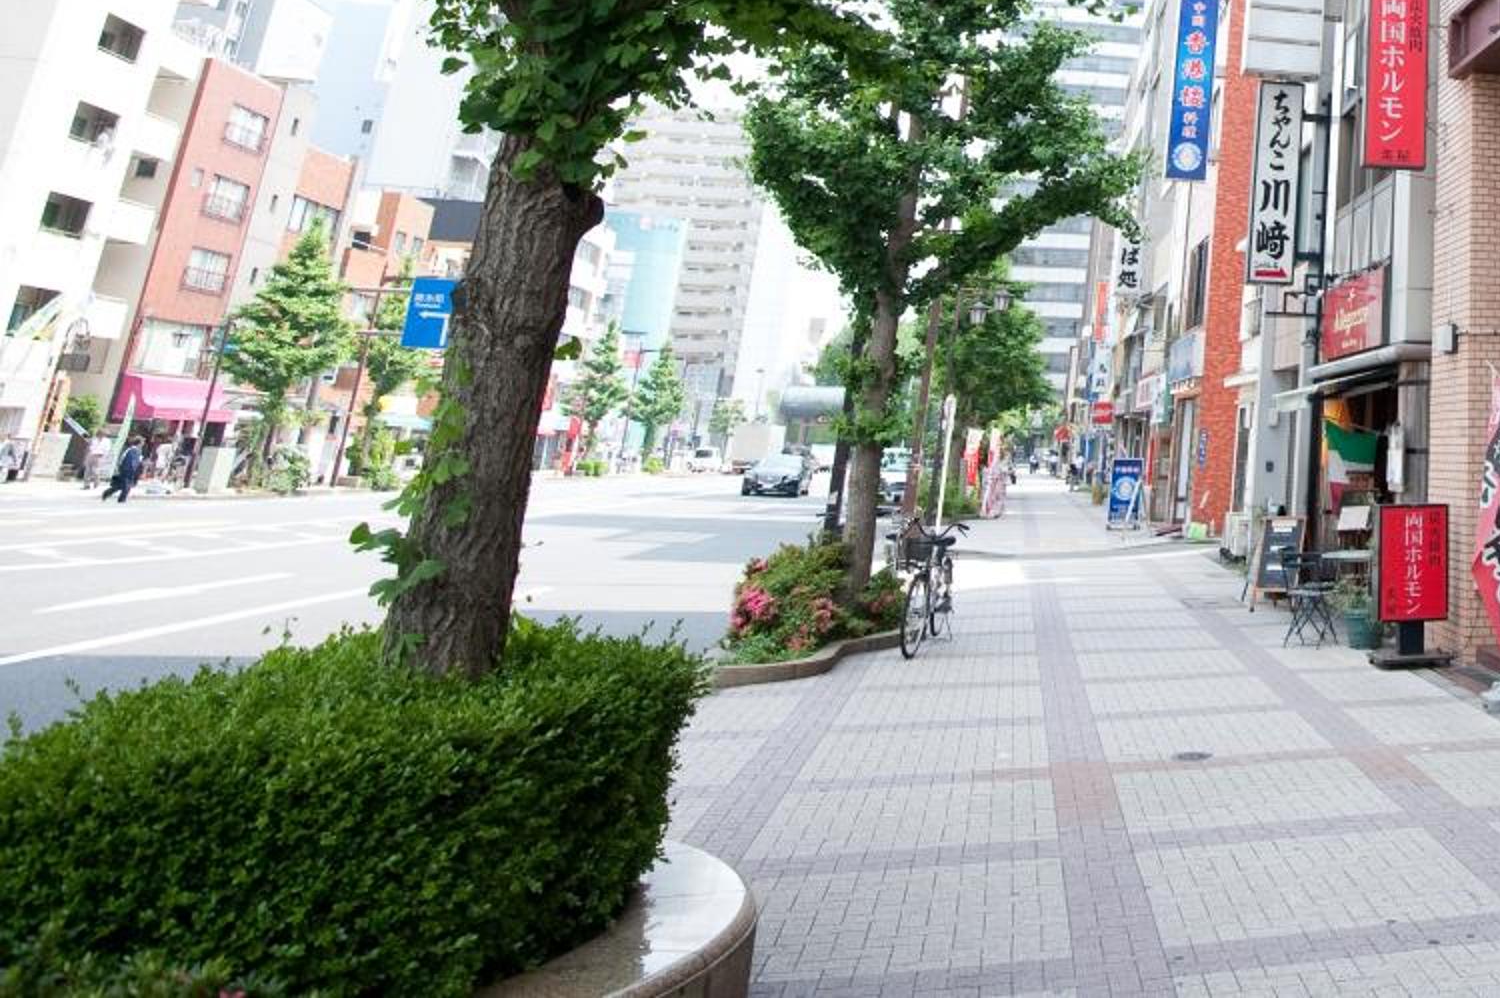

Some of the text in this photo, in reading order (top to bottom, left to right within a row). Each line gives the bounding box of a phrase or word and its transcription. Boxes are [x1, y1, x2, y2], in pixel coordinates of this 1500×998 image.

[1404, 510, 1424, 615] 両国ホルモン
